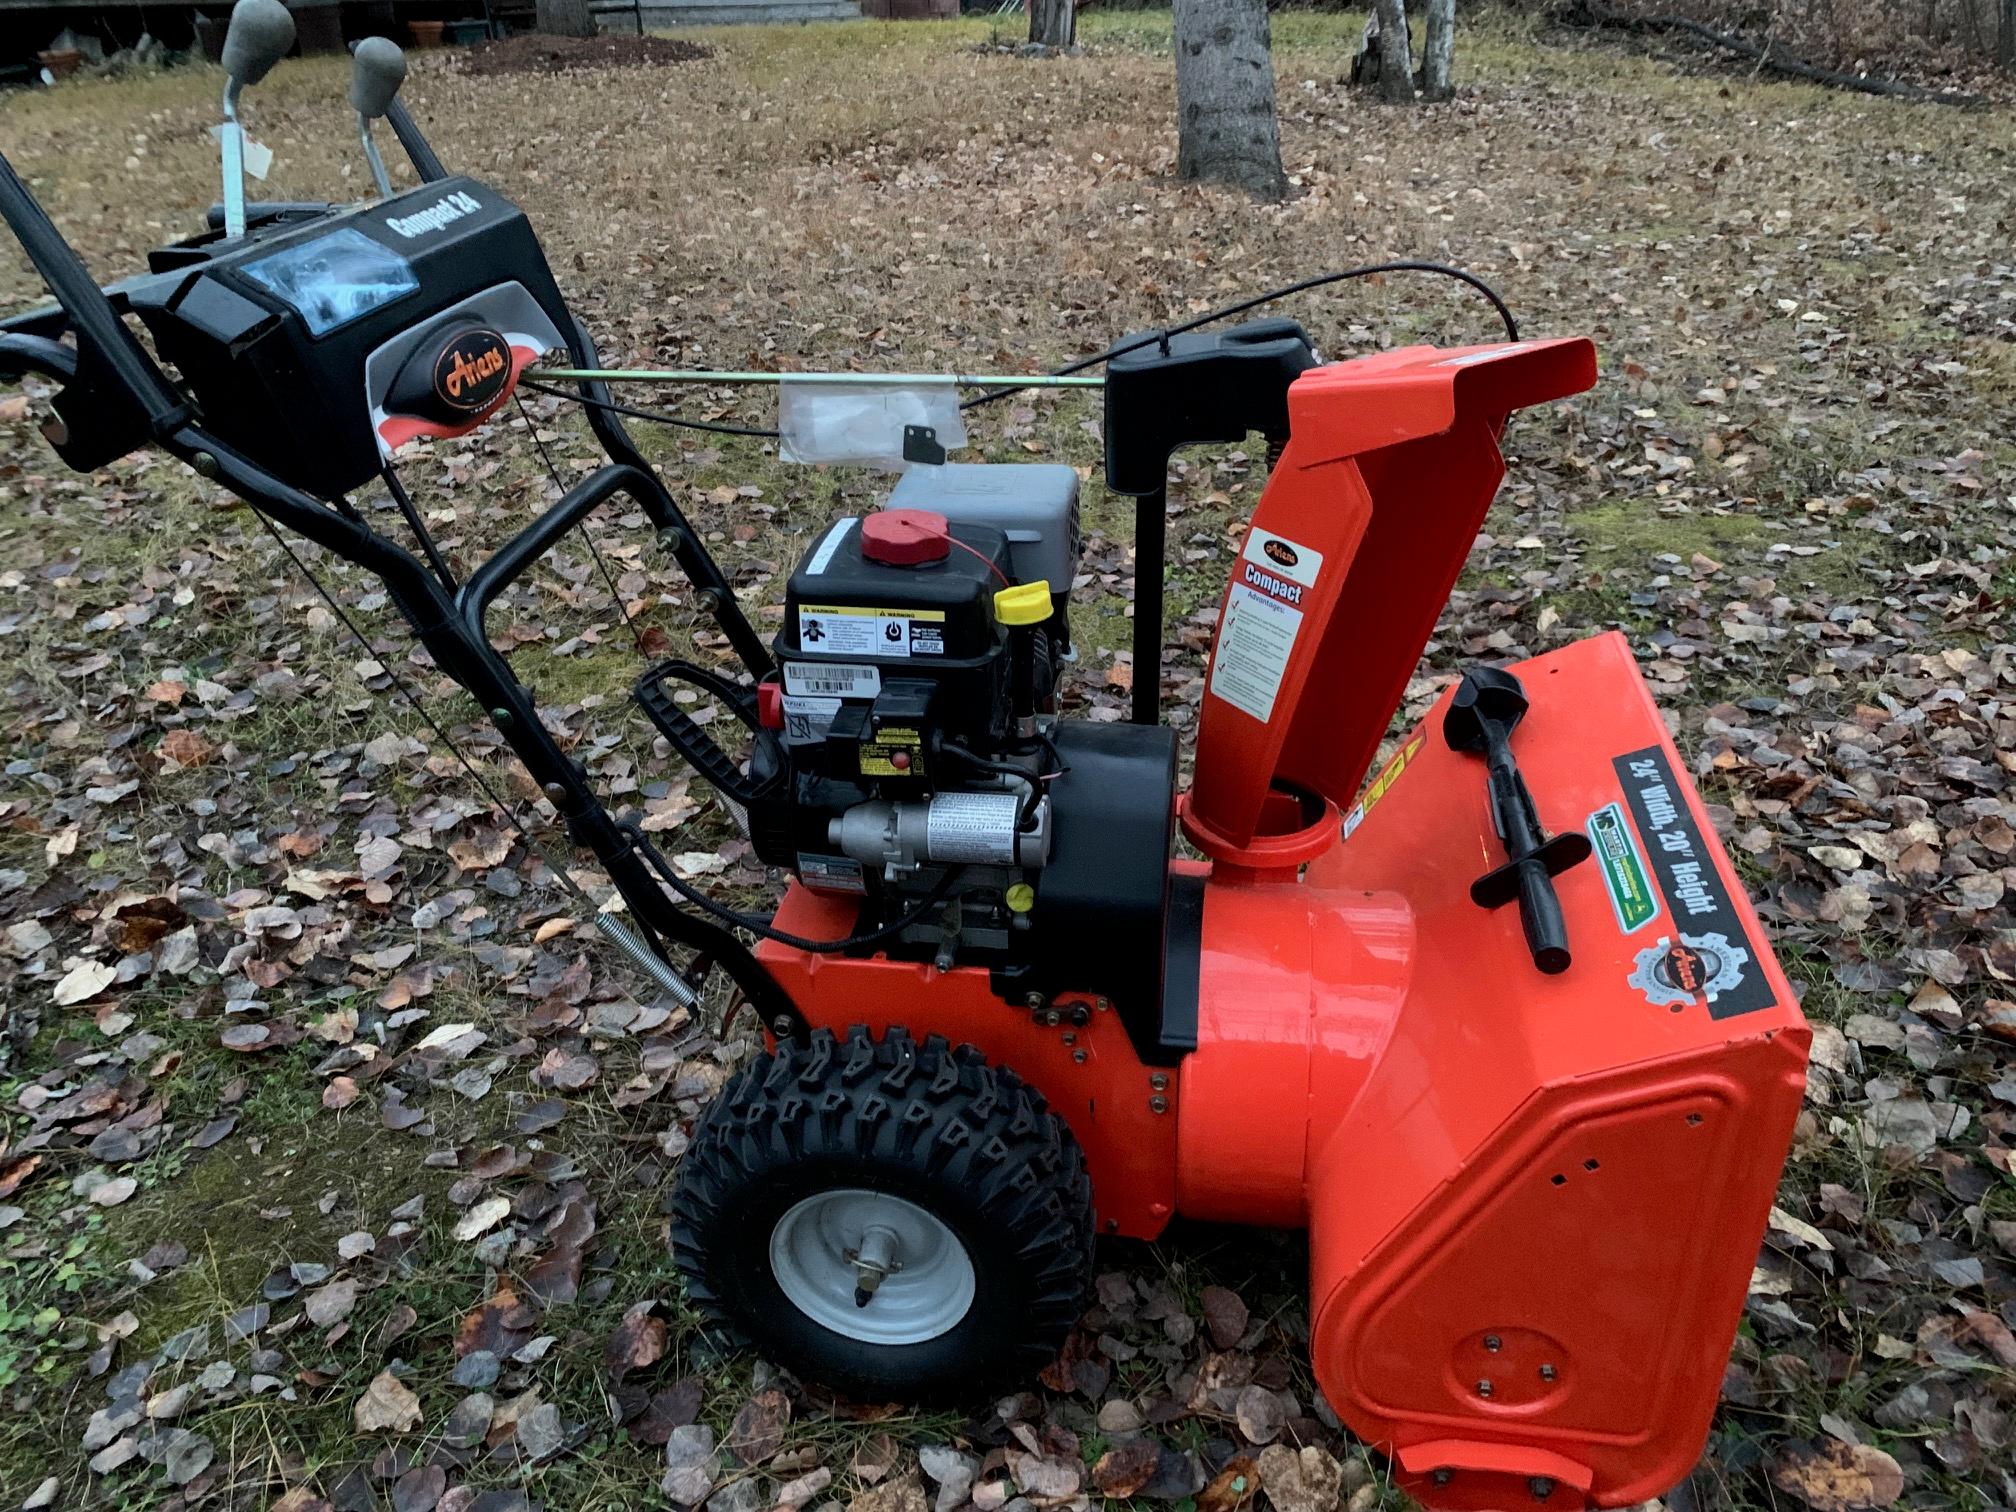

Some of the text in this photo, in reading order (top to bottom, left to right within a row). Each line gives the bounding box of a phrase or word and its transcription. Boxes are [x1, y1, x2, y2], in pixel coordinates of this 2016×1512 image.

[386, 190, 482, 239] Compact 24
[446, 346, 503, 398] Ariens
[1265, 543, 1296, 565] Ariens
[1244, 562, 1302, 604] Compact
[887, 611, 916, 619] WARNING
[1639, 784, 1678, 831] Width,
[1657, 830, 1695, 858] 20"
[1669, 860, 1718, 916] Height
[1671, 948, 1698, 990] Ariens
